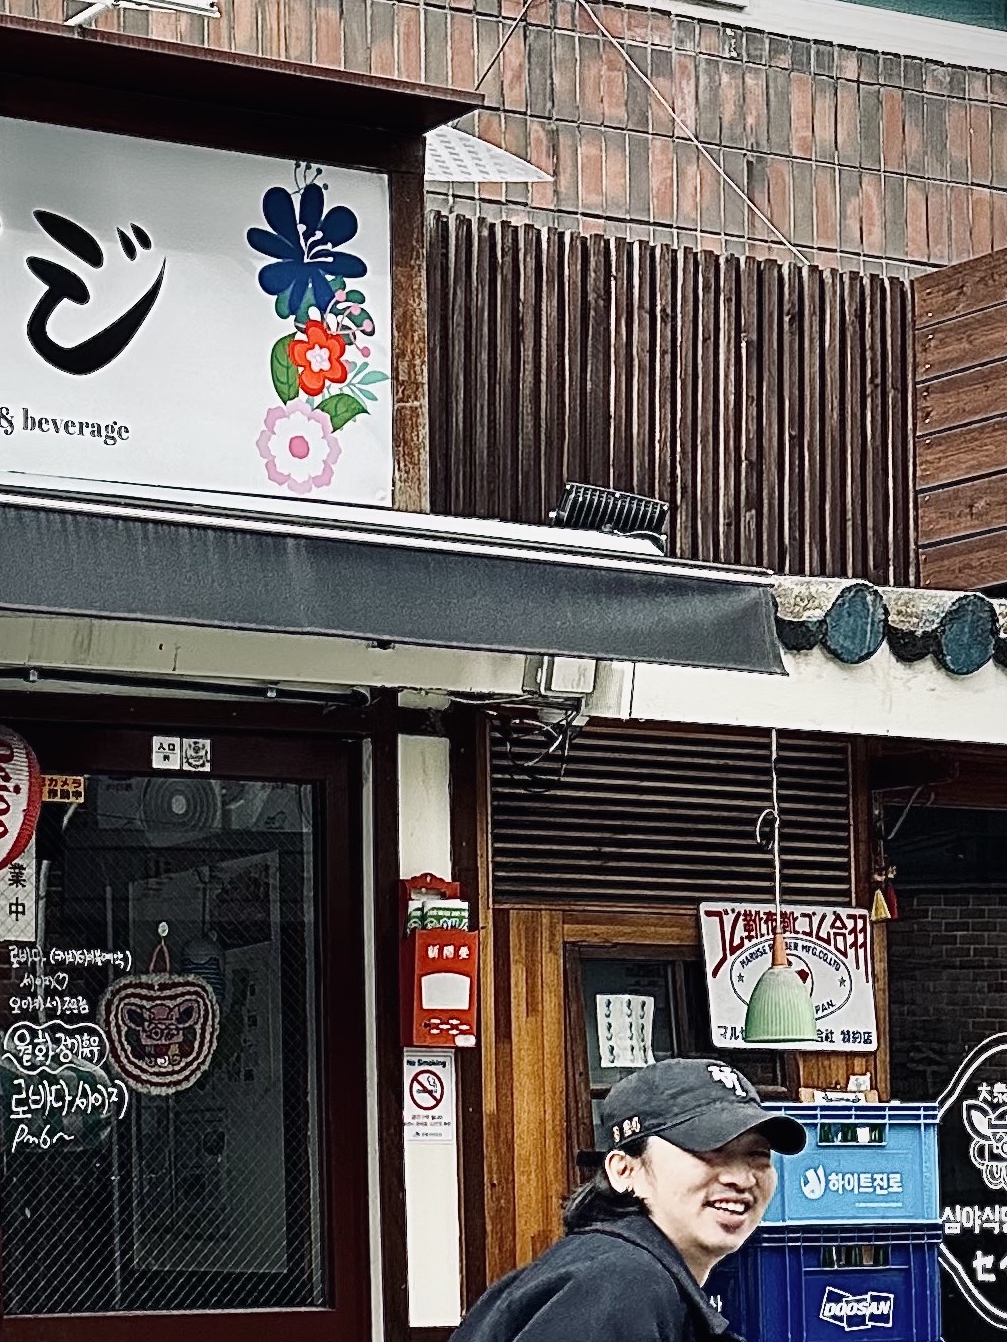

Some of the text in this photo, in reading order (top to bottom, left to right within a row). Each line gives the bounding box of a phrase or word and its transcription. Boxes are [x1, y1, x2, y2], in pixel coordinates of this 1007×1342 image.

[21, 407, 131, 446] beverage
[7, 861, 28, 922] 業中
[827, 1172, 903, 1195] 하이트진로
[823, 1299, 891, 1317] DOOSAN
